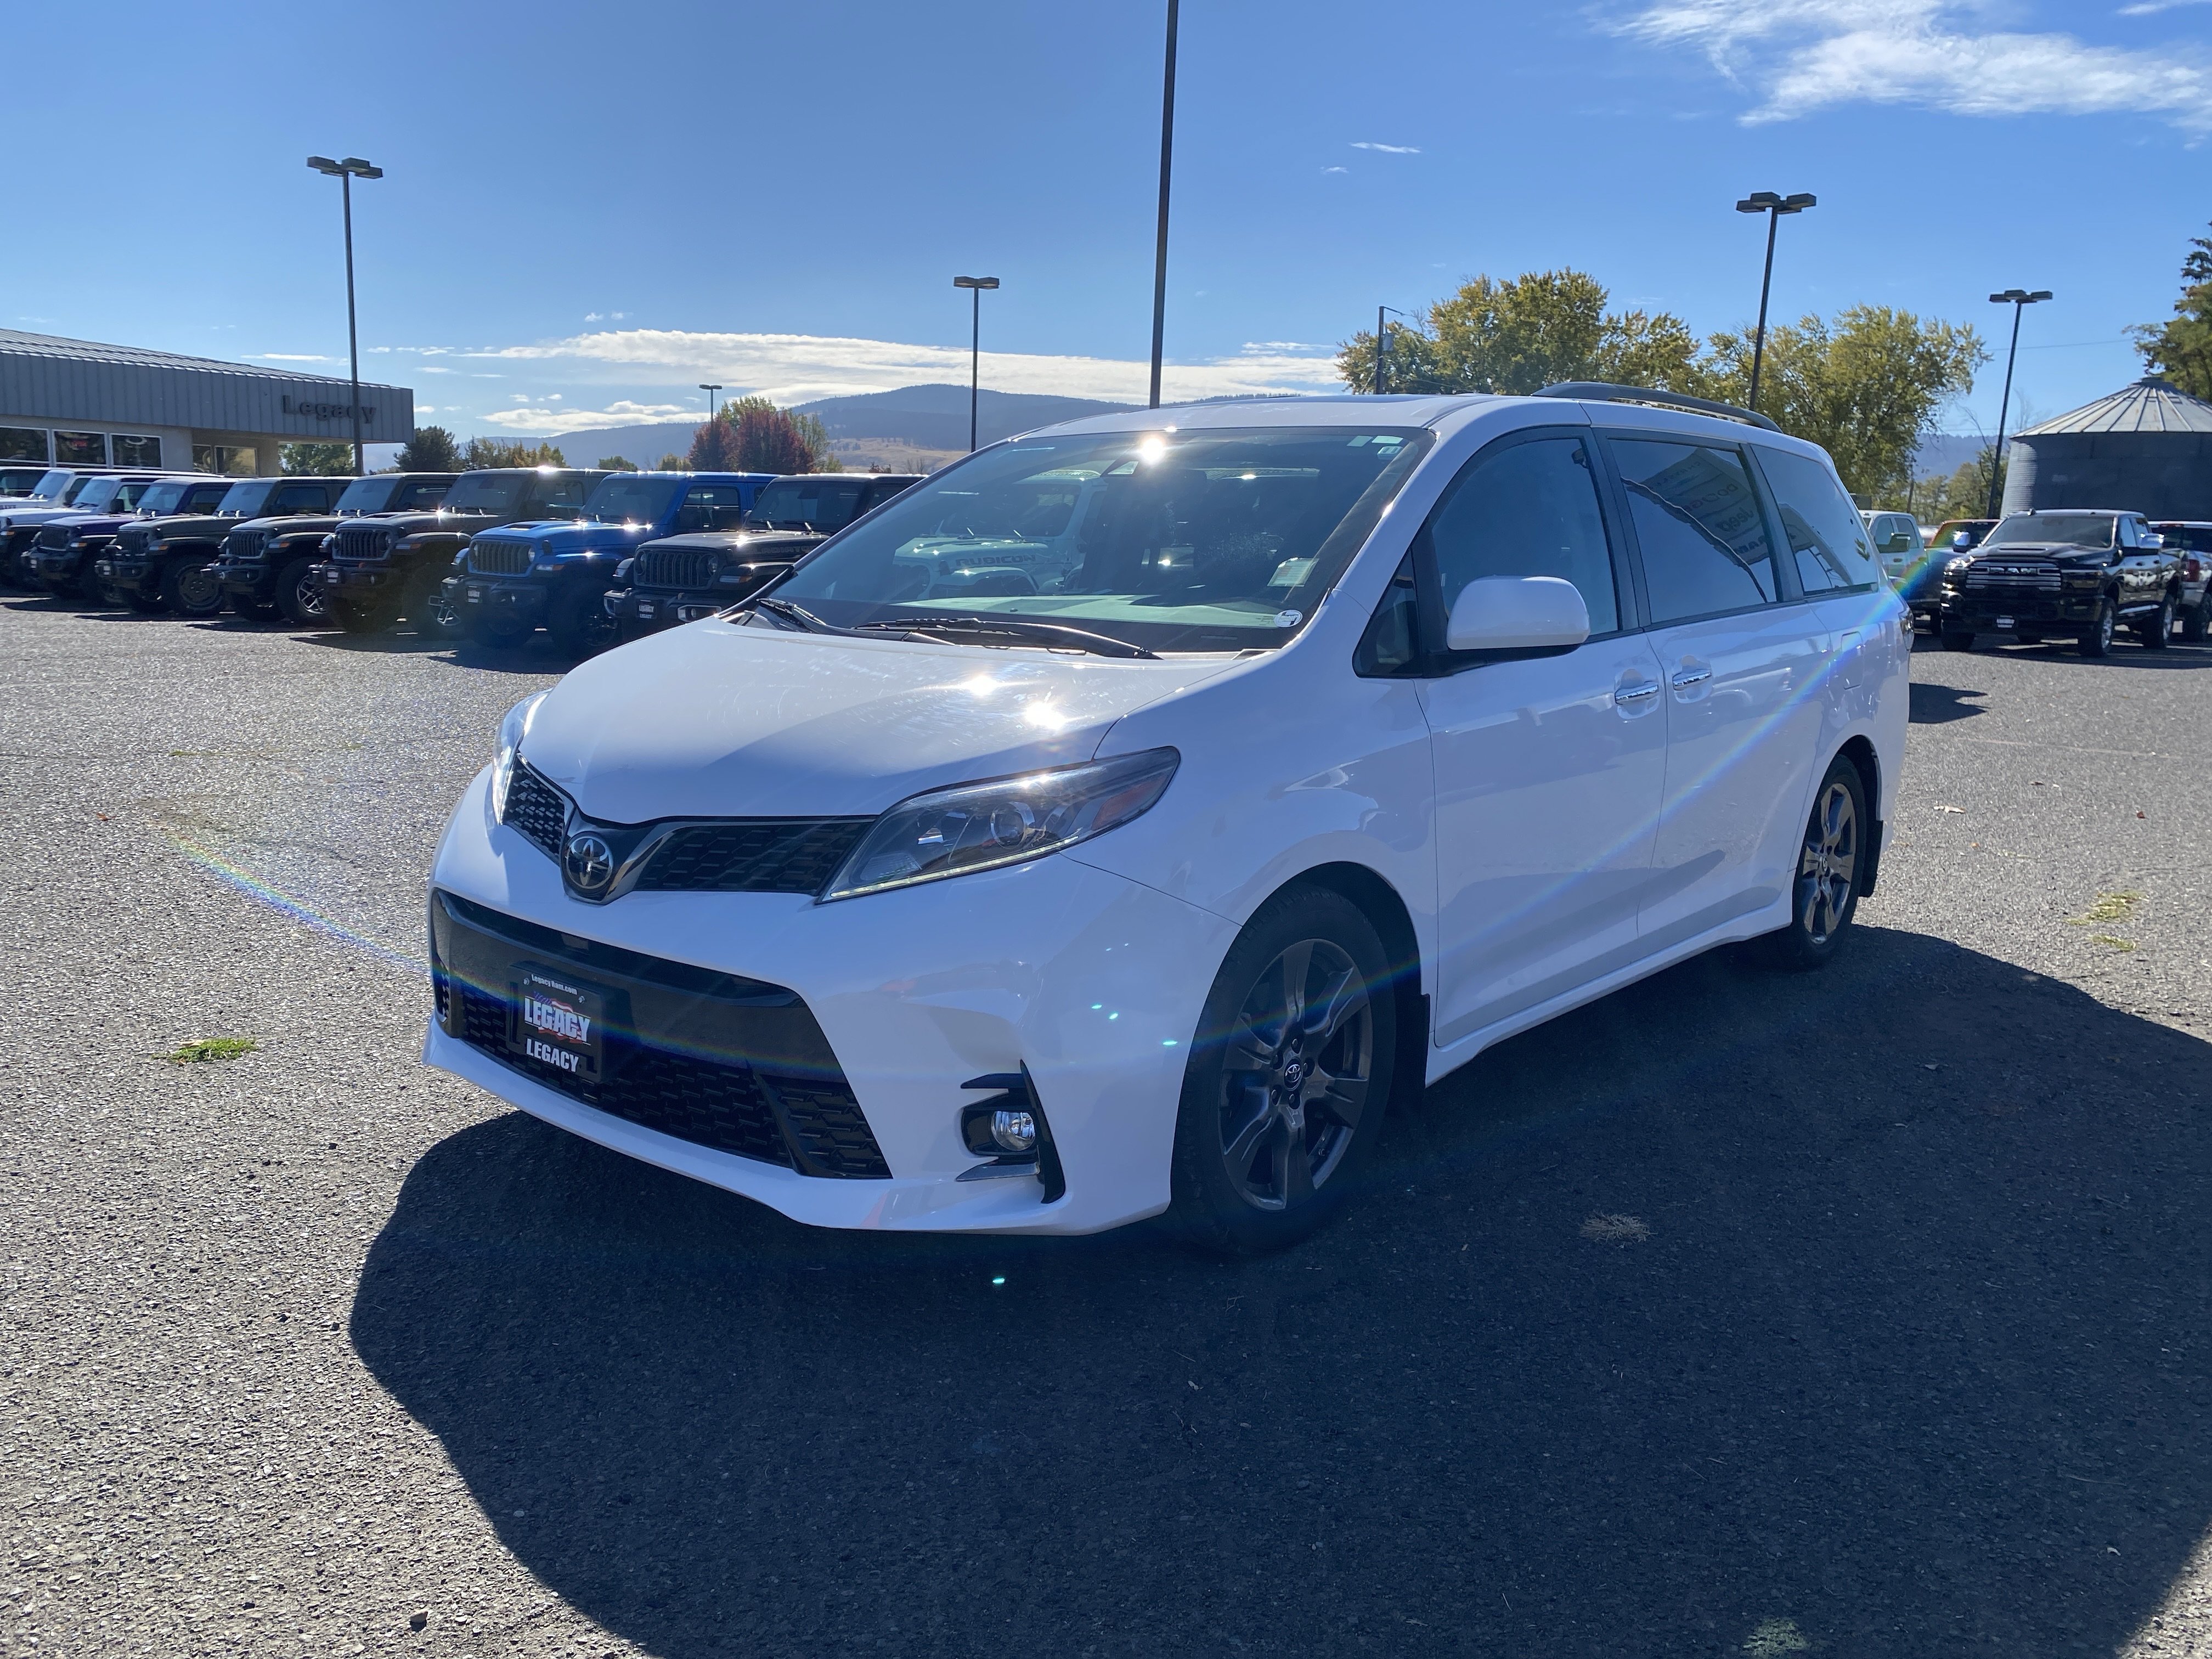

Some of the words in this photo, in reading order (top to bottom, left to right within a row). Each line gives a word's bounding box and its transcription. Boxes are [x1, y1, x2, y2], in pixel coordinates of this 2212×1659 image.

[955, 555, 1036, 567] RUBICON
[524, 997, 590, 1042] LEGACY
[527, 1038, 579, 1073] LEGACY
